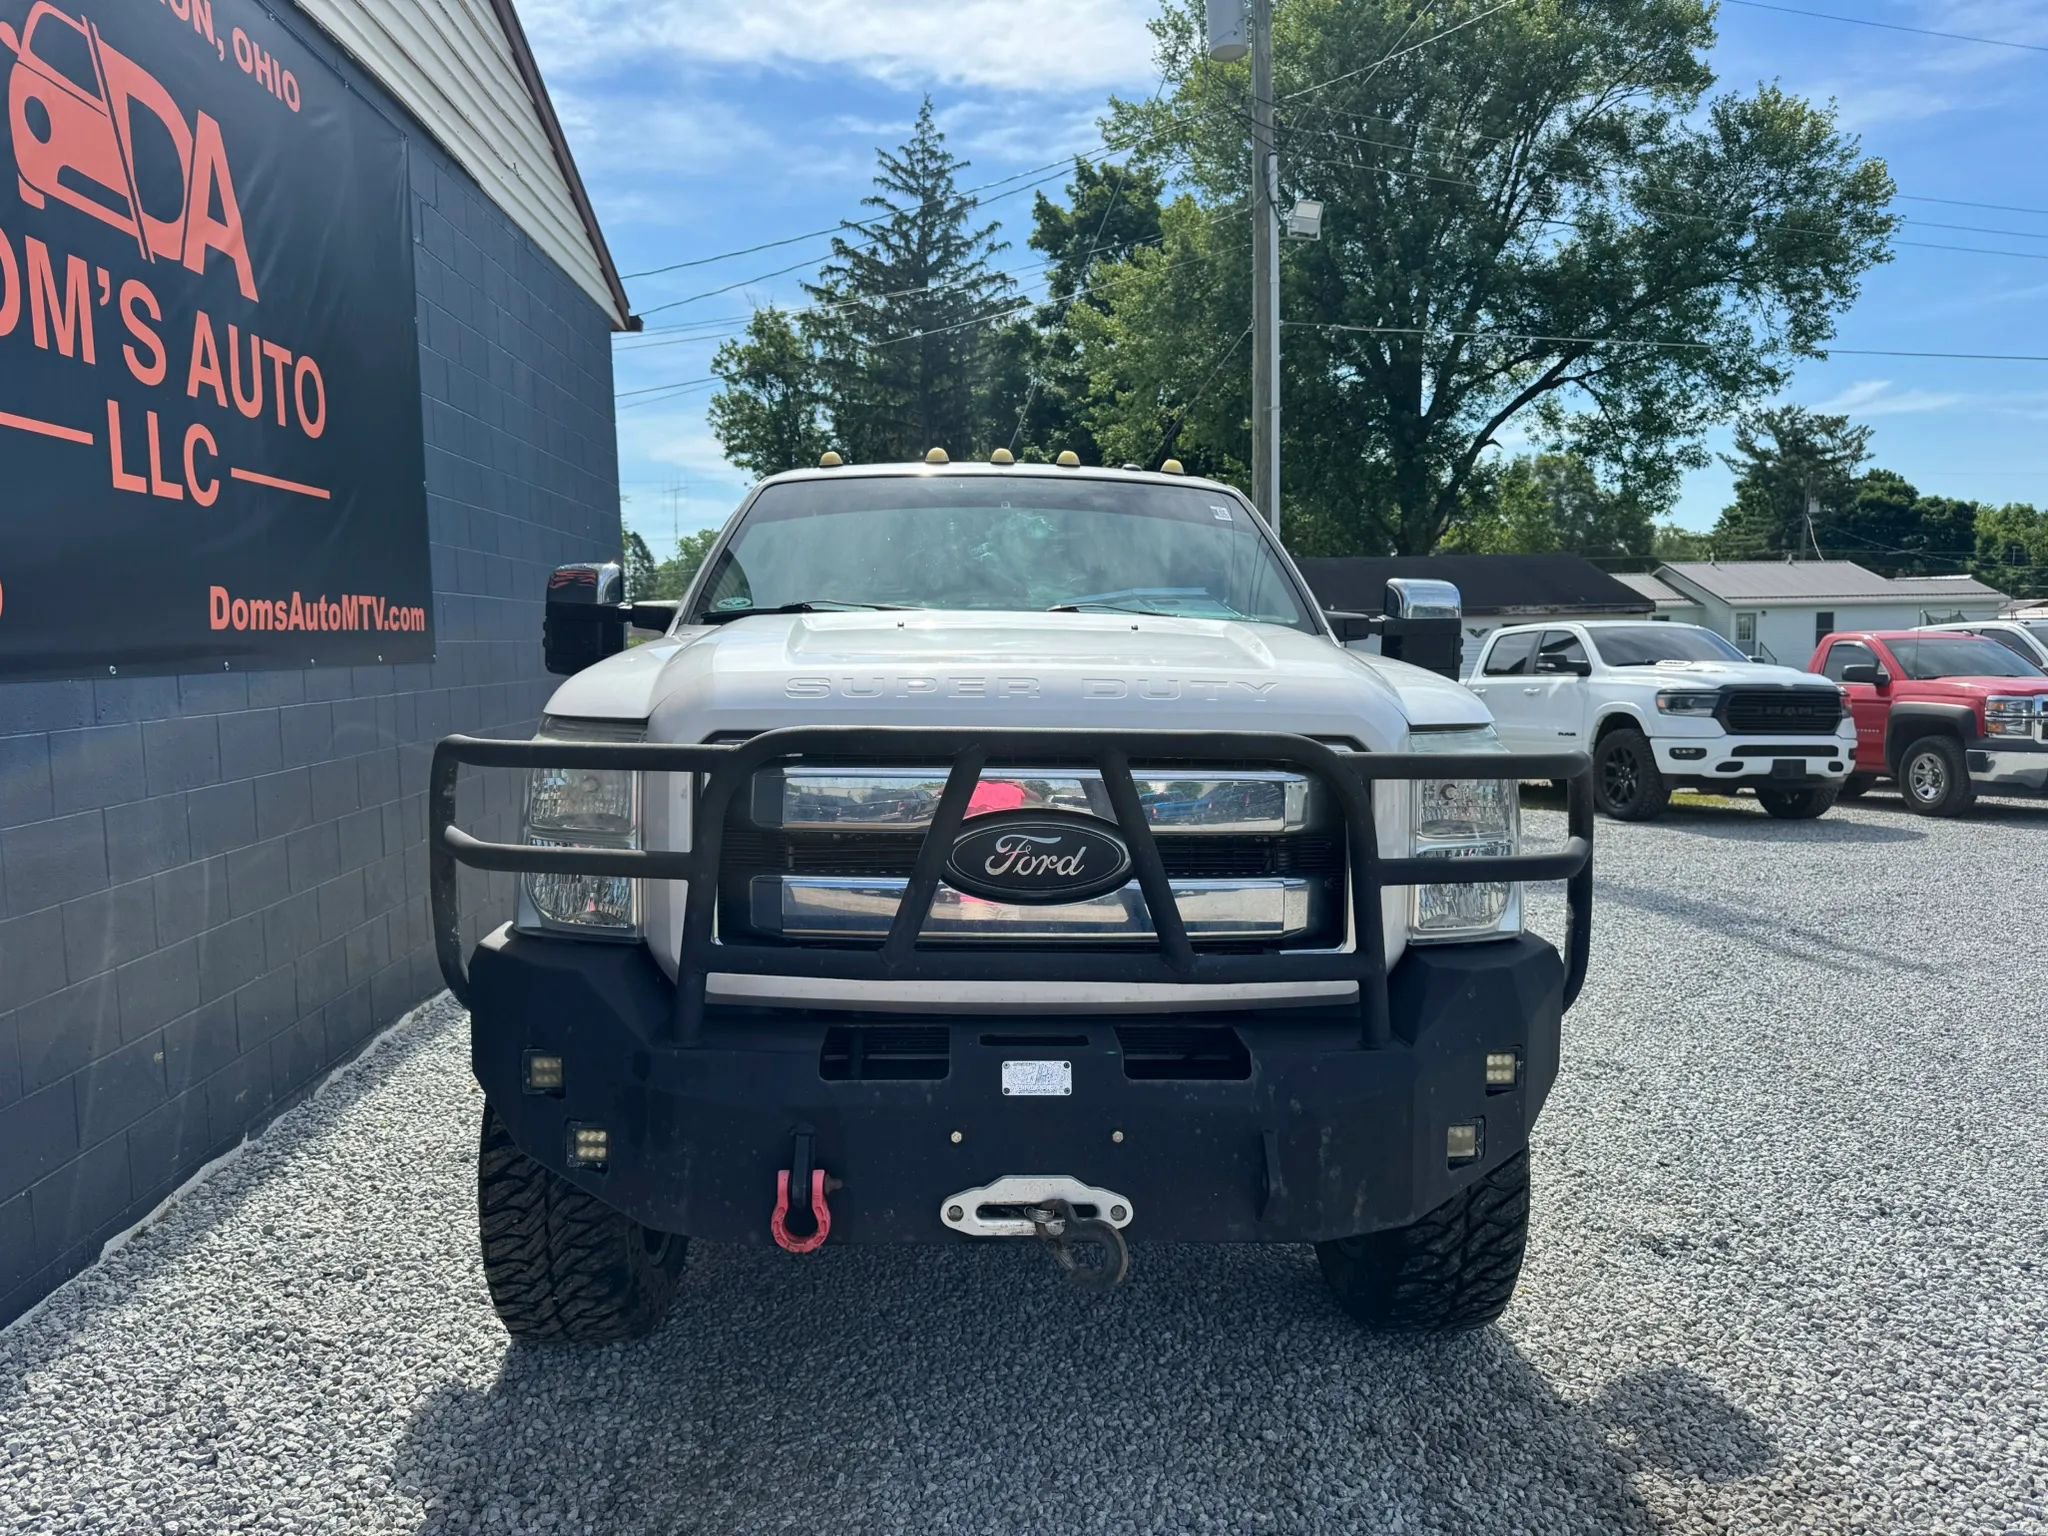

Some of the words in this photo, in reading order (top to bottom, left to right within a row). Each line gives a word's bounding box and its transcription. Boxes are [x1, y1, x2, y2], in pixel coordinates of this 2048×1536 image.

[232, 27, 301, 113] OHIO
[186, 310, 326, 439] AUTO
[107, 399, 220, 507] LLC
[209, 585, 426, 632] DomsAutoMTV.com
[784, 676, 1041, 699] SUPER
[1081, 677, 1280, 702] DUTY
[984, 833, 1086, 877] Ford
